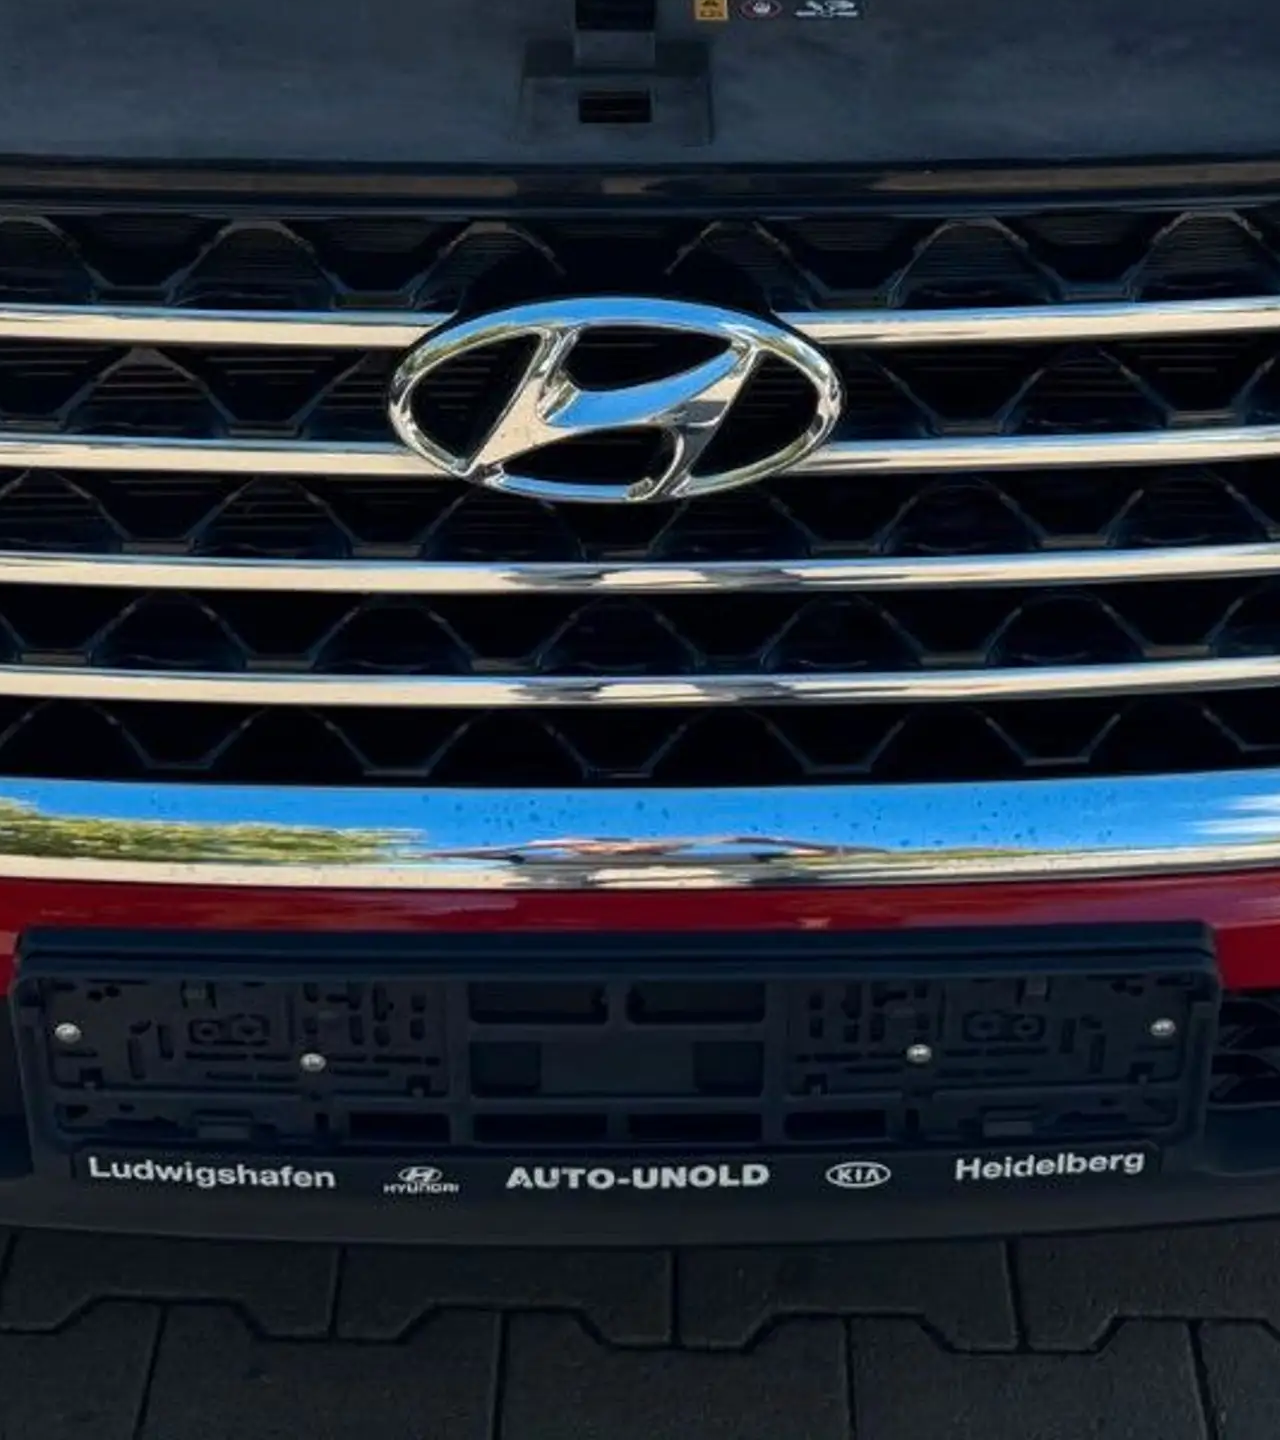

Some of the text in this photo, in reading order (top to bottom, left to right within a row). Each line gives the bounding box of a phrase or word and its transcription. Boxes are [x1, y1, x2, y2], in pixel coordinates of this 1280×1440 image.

[88, 1156, 336, 1189] Ludwigshafen
[505, 1163, 771, 1190] AUTO-UNOLD
[955, 1152, 1145, 1181] Heidelberg
